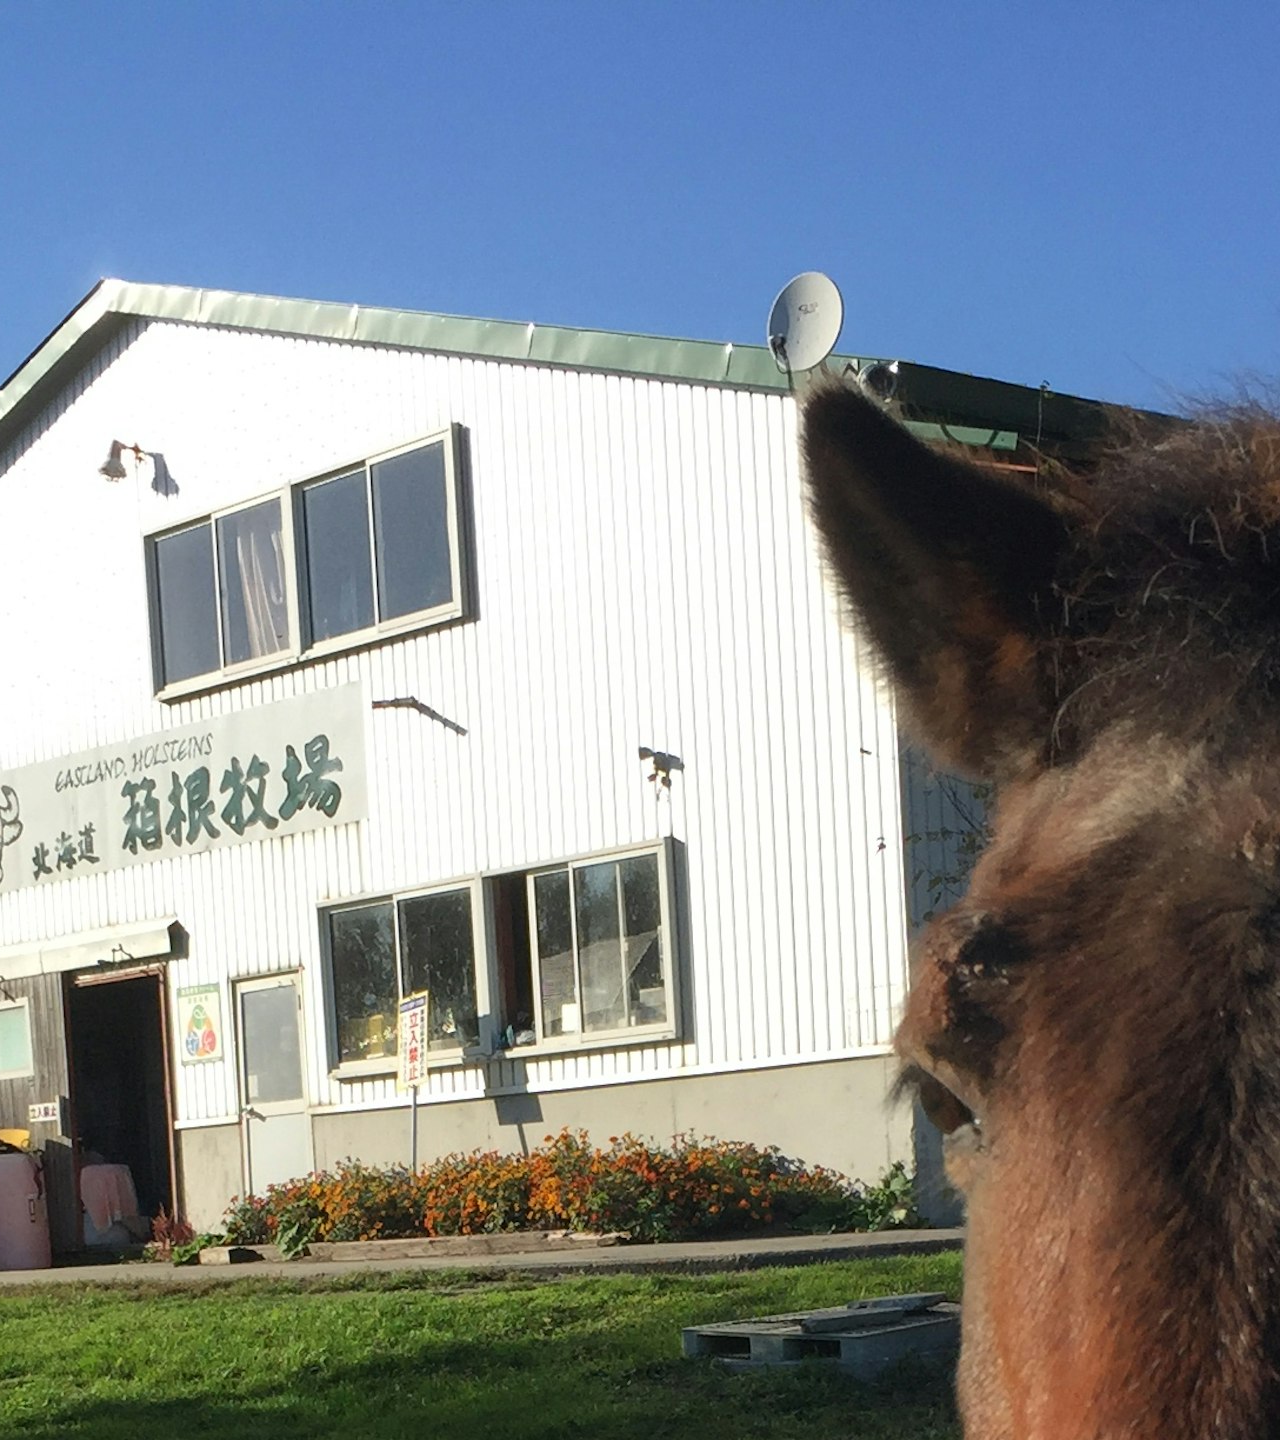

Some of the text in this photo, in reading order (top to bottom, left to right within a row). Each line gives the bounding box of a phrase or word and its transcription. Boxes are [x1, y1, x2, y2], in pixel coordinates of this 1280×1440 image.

[131, 732, 214, 773] HOLSTEINS
[32, 734, 344, 881] 北海道 箱根牧場
[408, 1011, 419, 1082] 立入禁止
